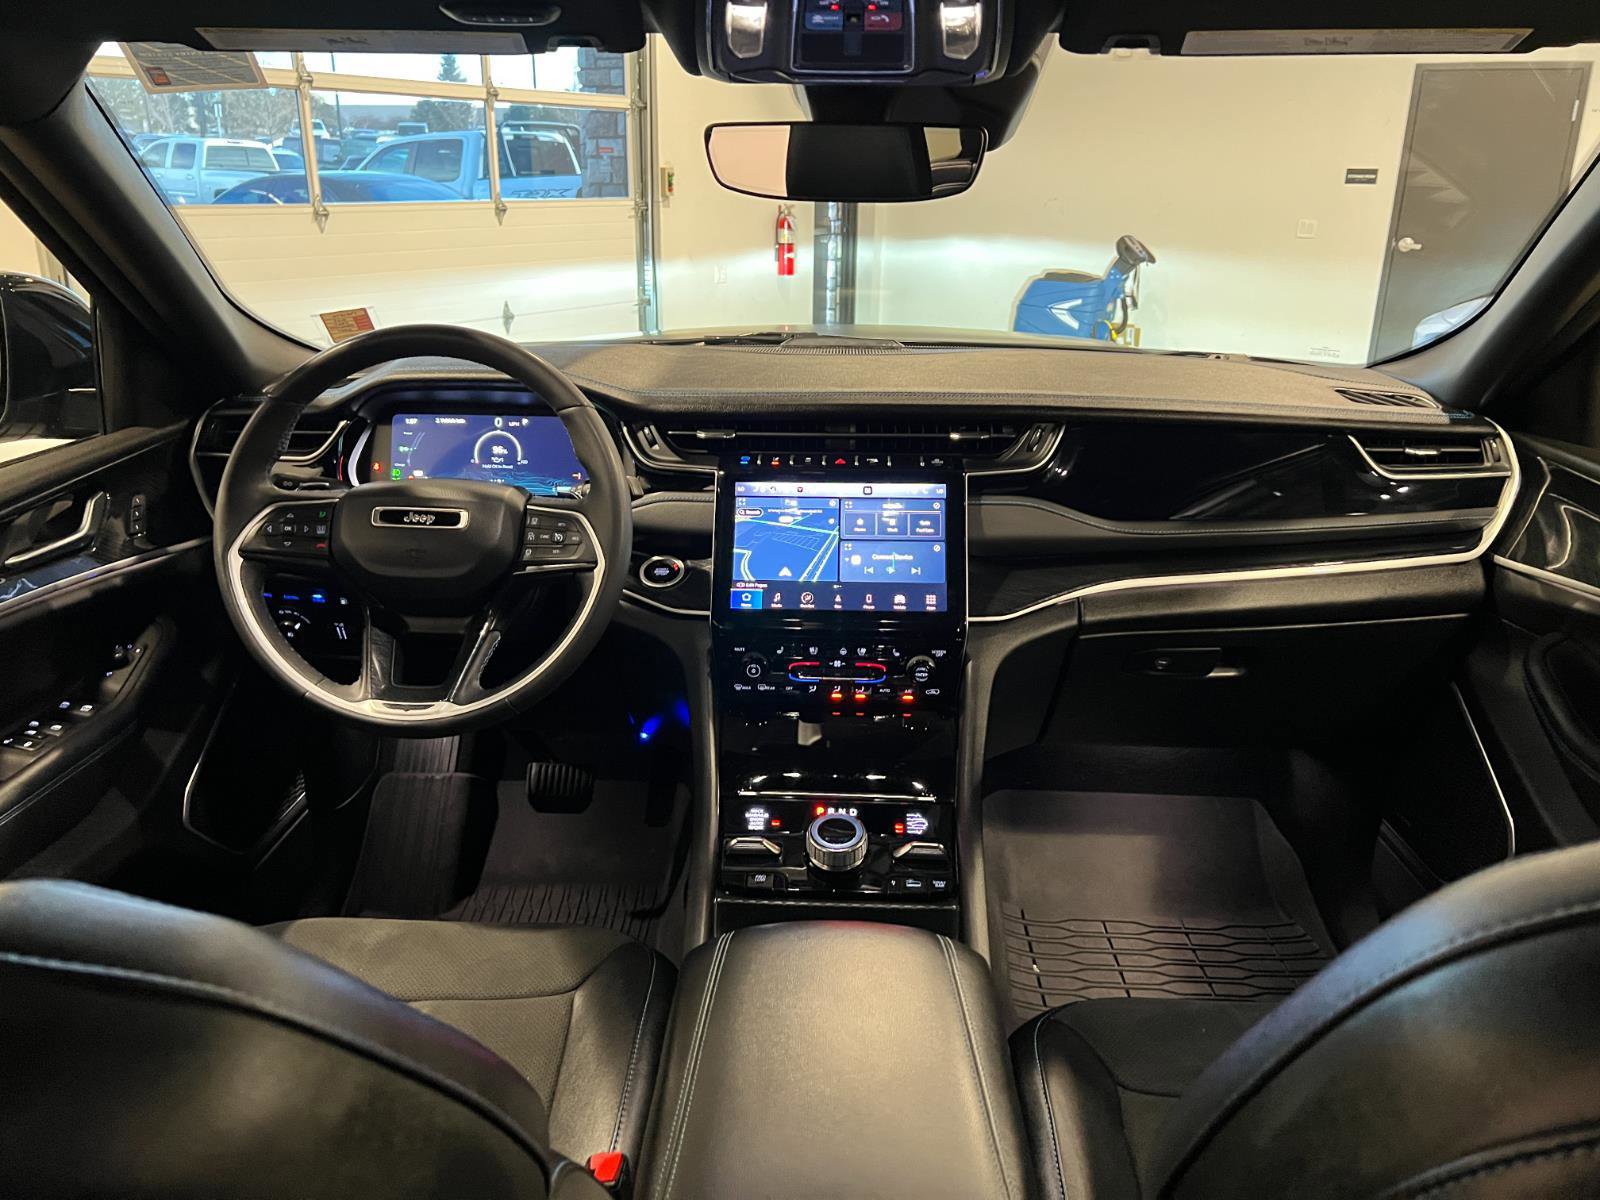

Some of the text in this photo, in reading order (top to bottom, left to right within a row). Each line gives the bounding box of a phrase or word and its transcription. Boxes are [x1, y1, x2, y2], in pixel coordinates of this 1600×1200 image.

[494, 417, 503, 427] 0
[404, 512, 436, 525] Jeep
[816, 806, 824, 816] P
[850, 808, 858, 816] D
